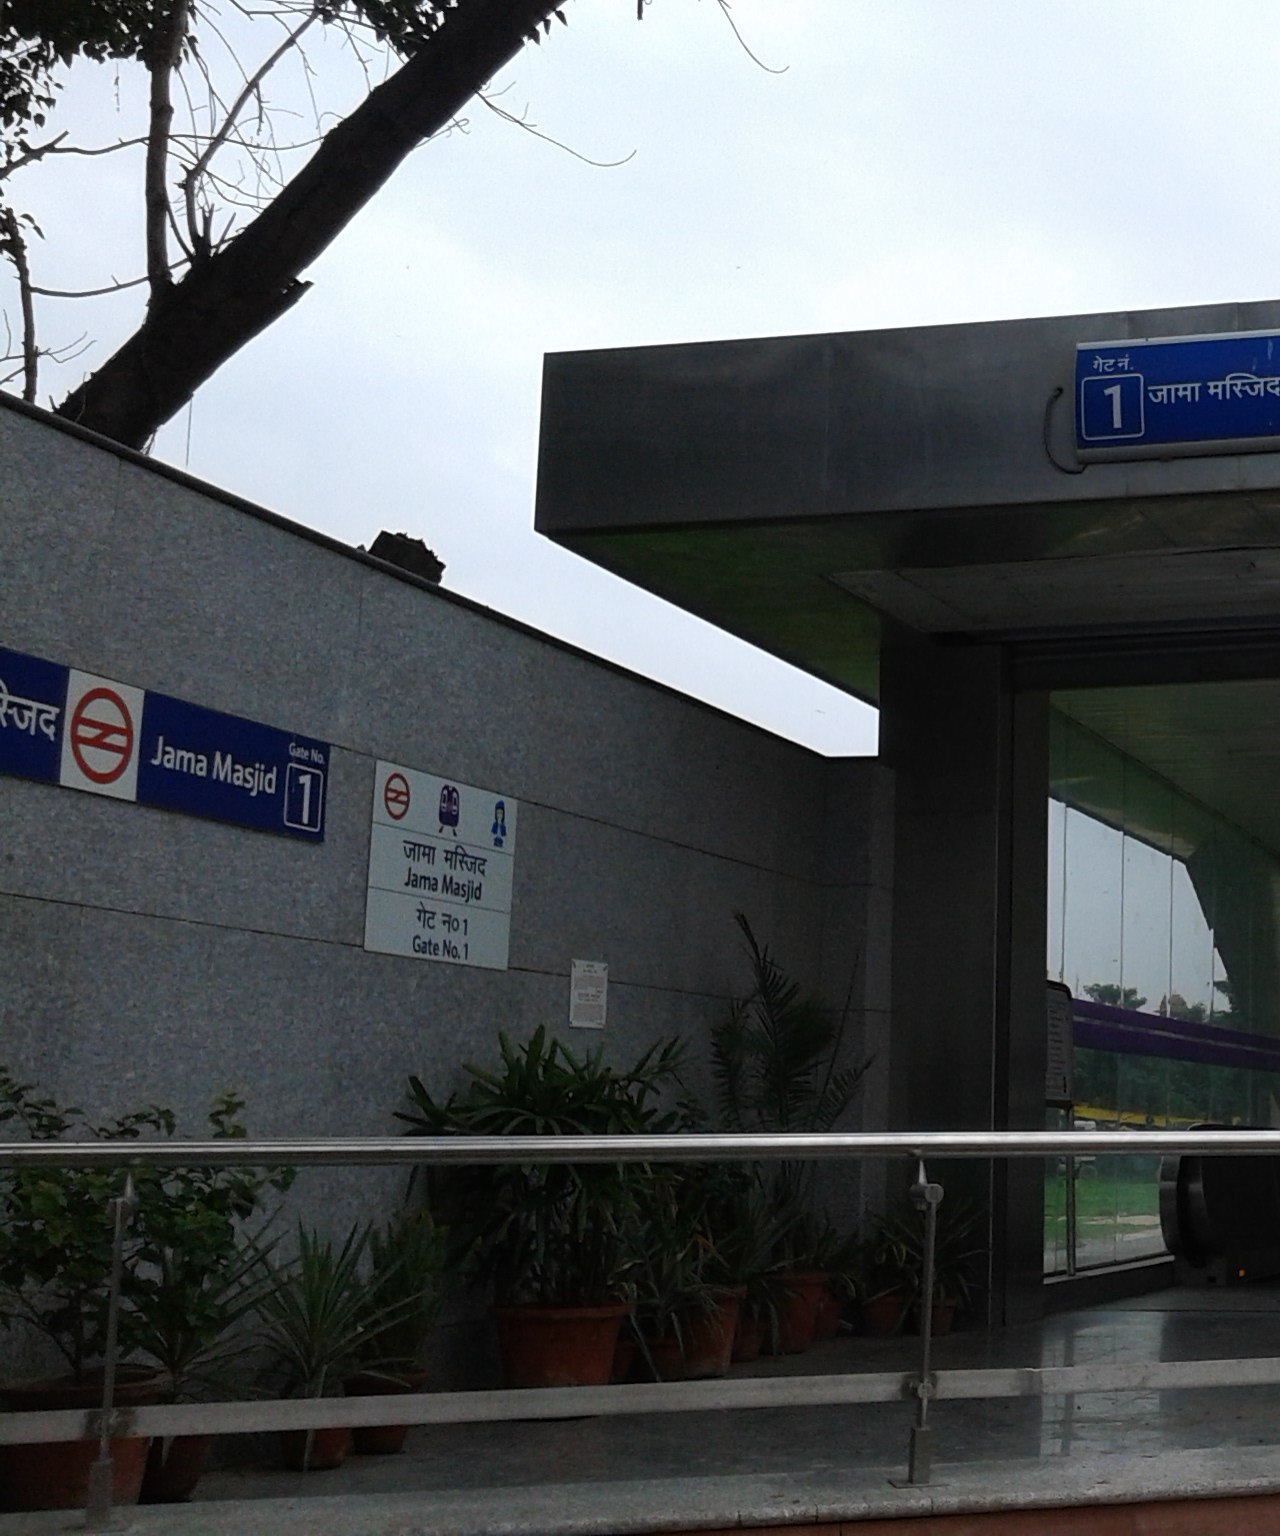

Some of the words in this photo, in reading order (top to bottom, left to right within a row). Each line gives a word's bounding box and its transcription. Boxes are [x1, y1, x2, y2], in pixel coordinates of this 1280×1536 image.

[1093, 355, 1115, 372] गेट
[1103, 384, 1122, 429] 1
[1148, 382, 1202, 405] जामा
[151, 735, 208, 778] Jama
[212, 750, 278, 797] Masjid
[288, 742, 309, 761] Gate
[310, 748, 326, 766] No.
[298, 774, 312, 825] 1
[403, 840, 436, 866] जामा
[443, 845, 488, 877] मस्जिद
[404, 867, 438, 892] Jama
[442, 874, 482, 903] Masjid
[416, 901, 437, 930] गेट
[463, 919, 468, 936] 1
[412, 935, 440, 956] Gate
[442, 940, 461, 960] No.
[464, 943, 469, 960] 1
